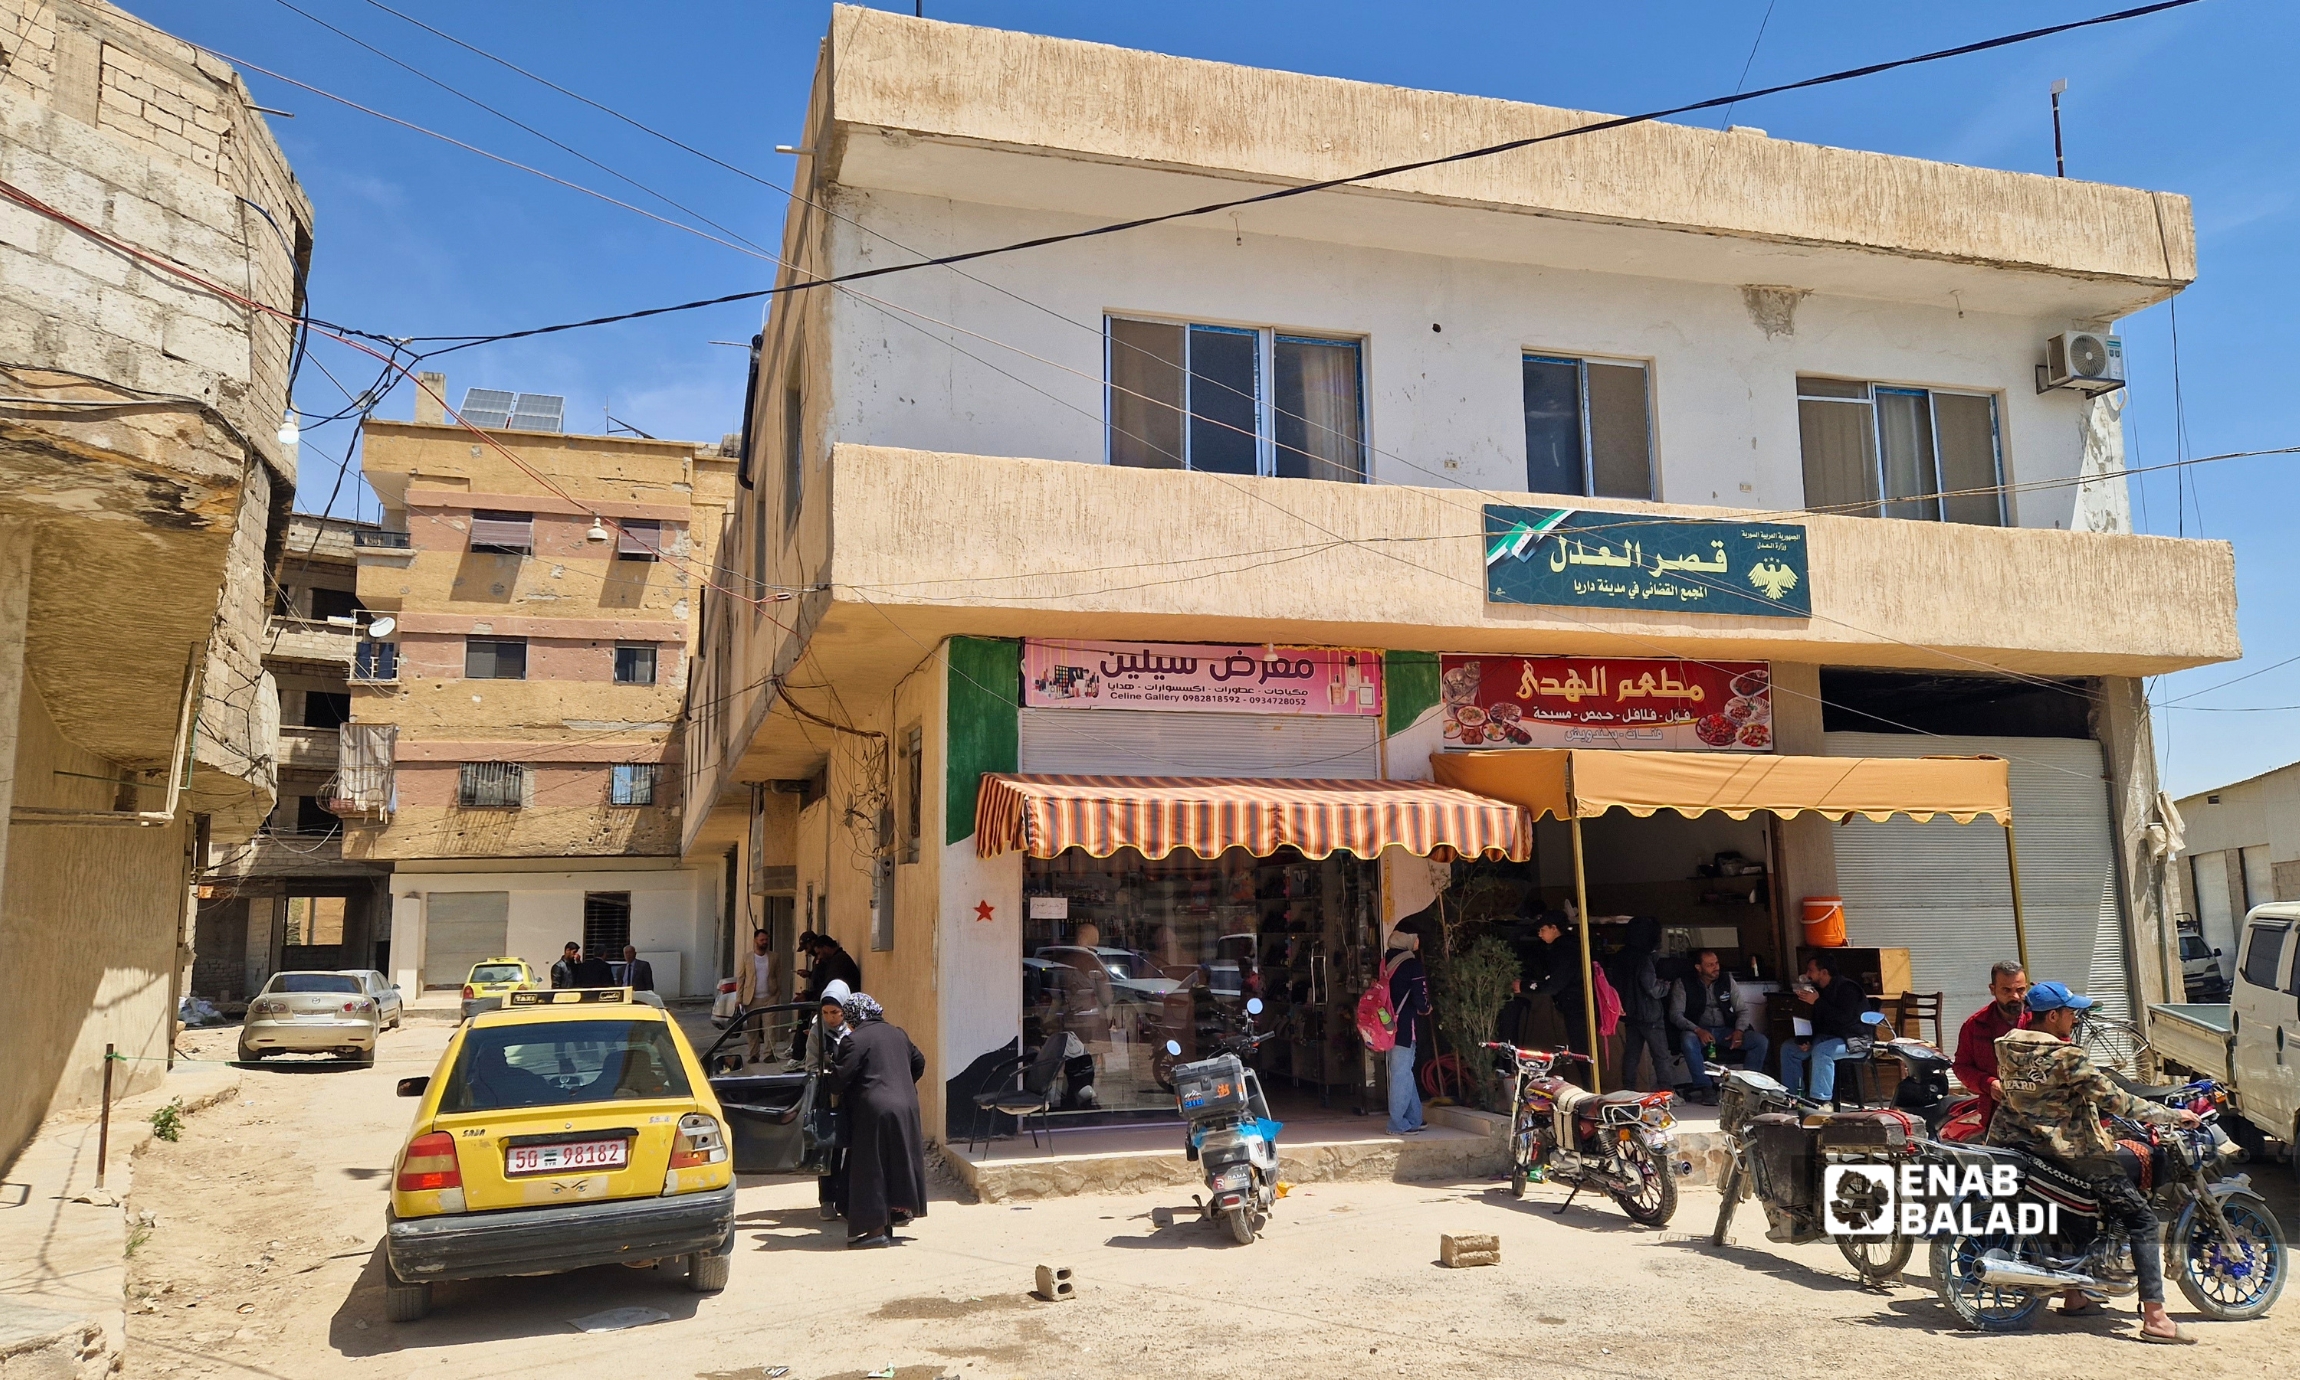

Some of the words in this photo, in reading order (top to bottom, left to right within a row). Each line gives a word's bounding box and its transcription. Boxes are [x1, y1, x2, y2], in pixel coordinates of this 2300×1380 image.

[1741, 529, 1760, 540] السورية
[1760, 530, 1778, 540] العربية
[1778, 532, 1801, 542] الجمهورية
[1550, 534, 1642, 573] العدل
[1756, 542, 1774, 550] العدل
[1775, 542, 1787, 551] وزارة
[1648, 539, 1728, 578] قصر
[1573, 578, 1596, 595] داريا
[1598, 578, 1626, 596] مدينة
[1628, 580, 1640, 600] في
[1642, 582, 1678, 600] القضائي
[1680, 586, 1708, 602] المجمع
[1100, 648, 1198, 680] سيلين
[1209, 650, 1316, 685] معرض
[1107, 682, 1135, 692] هدايا
[1144, 682, 1206, 694] اكسسوارات
[1516, 659, 1607, 703] الهدى
[1616, 666, 1706, 703] مطعم
[1110, 692, 1142, 701] Celine
[1144, 692, 1180, 704] Gallery
[1182, 694, 1241, 704] 0982818592
[1249, 696, 1306, 706] 0934728052
[1214, 686, 1254, 696] عطورات
[1264, 688, 1309, 696] مكياجات
[1533, 706, 1572, 723] مسبحة
[1580, 708, 1614, 722] حمص
[1622, 707, 1657, 723] فلافل
[1664, 708, 1691, 724] فول
[1564, 727, 1618, 742] سندويش
[2003, 1080, 2037, 1092] EARD
[516, 1150, 538, 1169] 50
[563, 1144, 619, 1165] 98182
